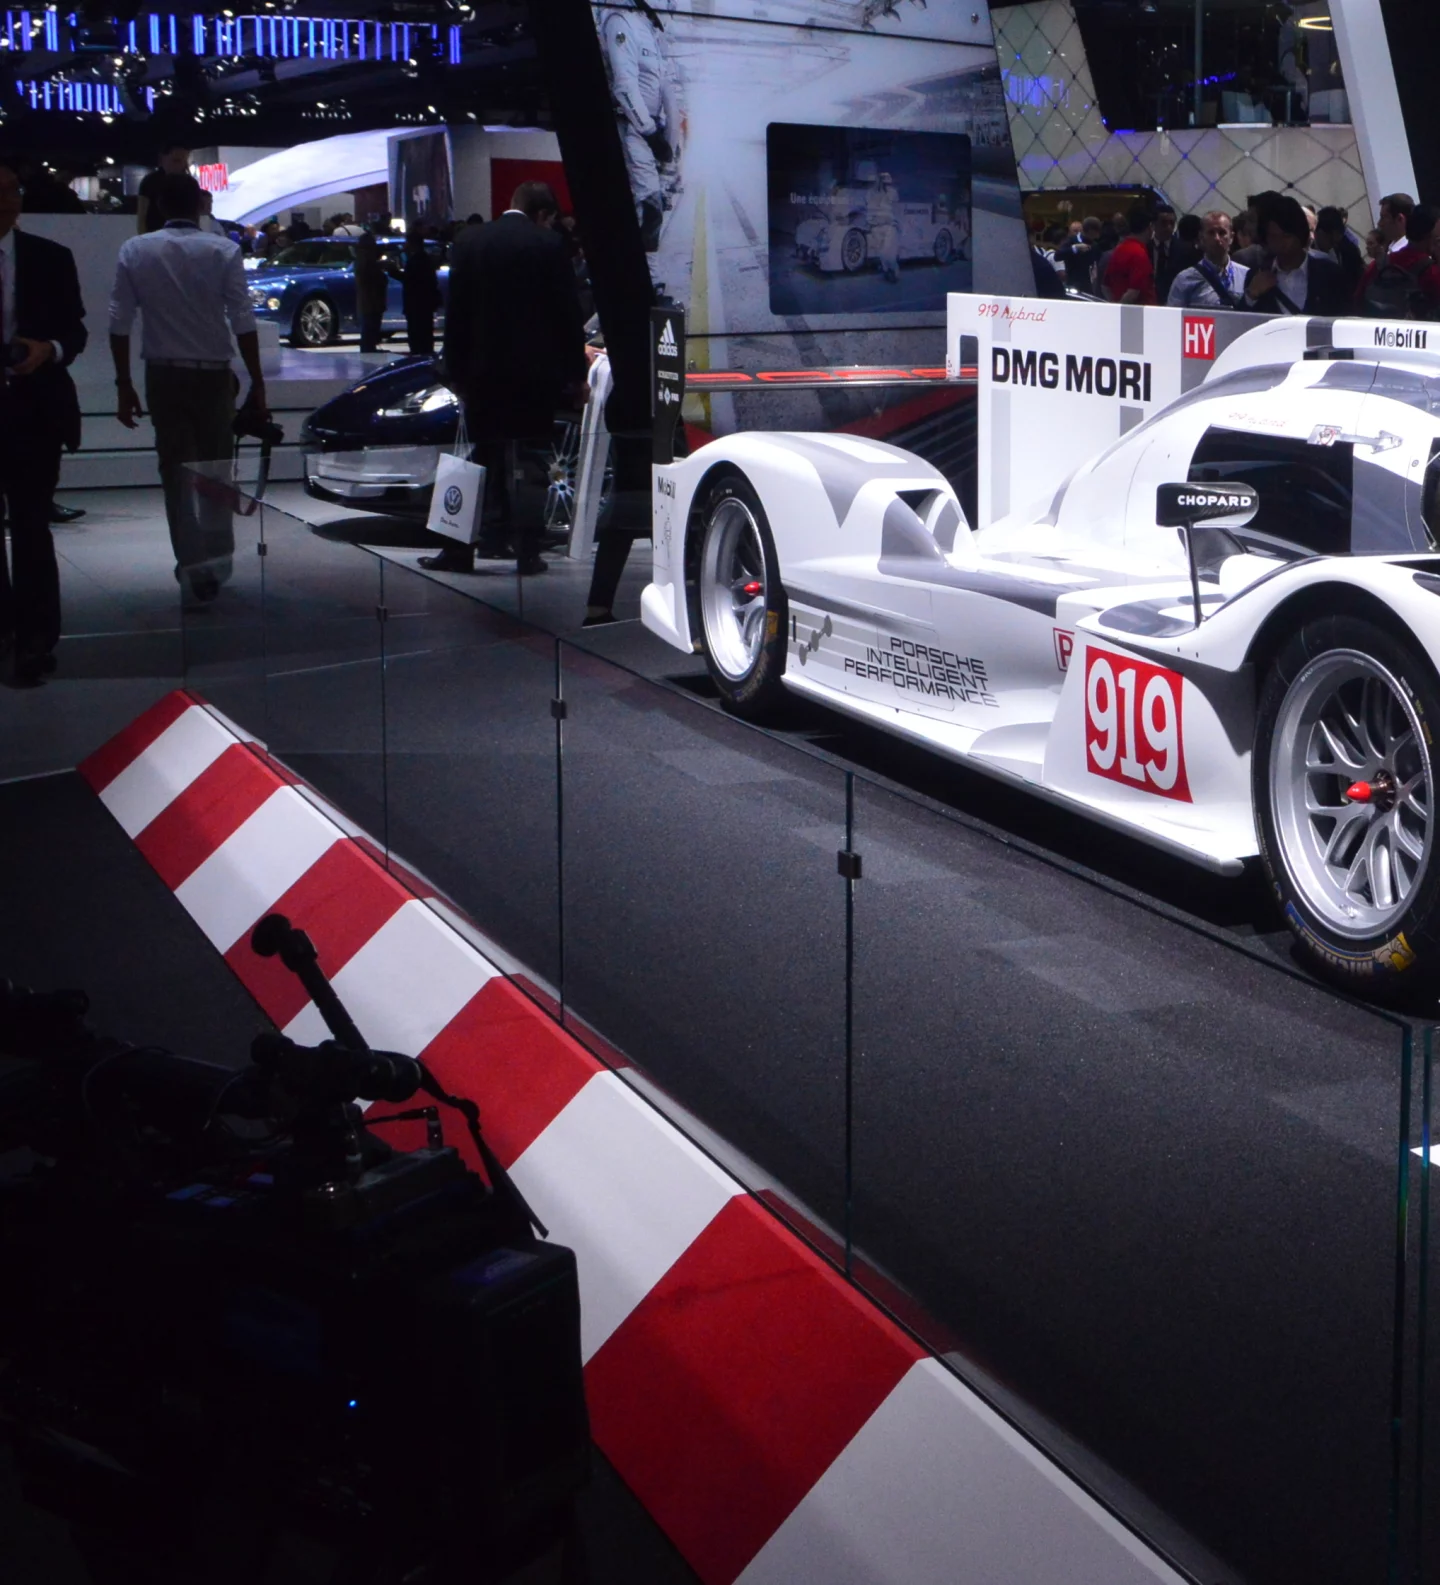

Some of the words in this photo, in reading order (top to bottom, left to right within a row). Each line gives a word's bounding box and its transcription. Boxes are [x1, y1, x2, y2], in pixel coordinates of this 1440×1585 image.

[977, 303, 999, 317] 919
[1001, 306, 1047, 328] hybrid
[1184, 322, 1214, 355] HY
[1374, 326, 1413, 348] Mobil
[991, 346, 1060, 390] DMG
[1065, 354, 1152, 402] MORI
[1177, 494, 1252, 507] CHOPARD
[866, 646, 989, 691] INTELLIGENT
[889, 636, 987, 676] PORSCHE
[844, 657, 1001, 709] PERFORMANCE
[1086, 657, 1180, 792] 919
